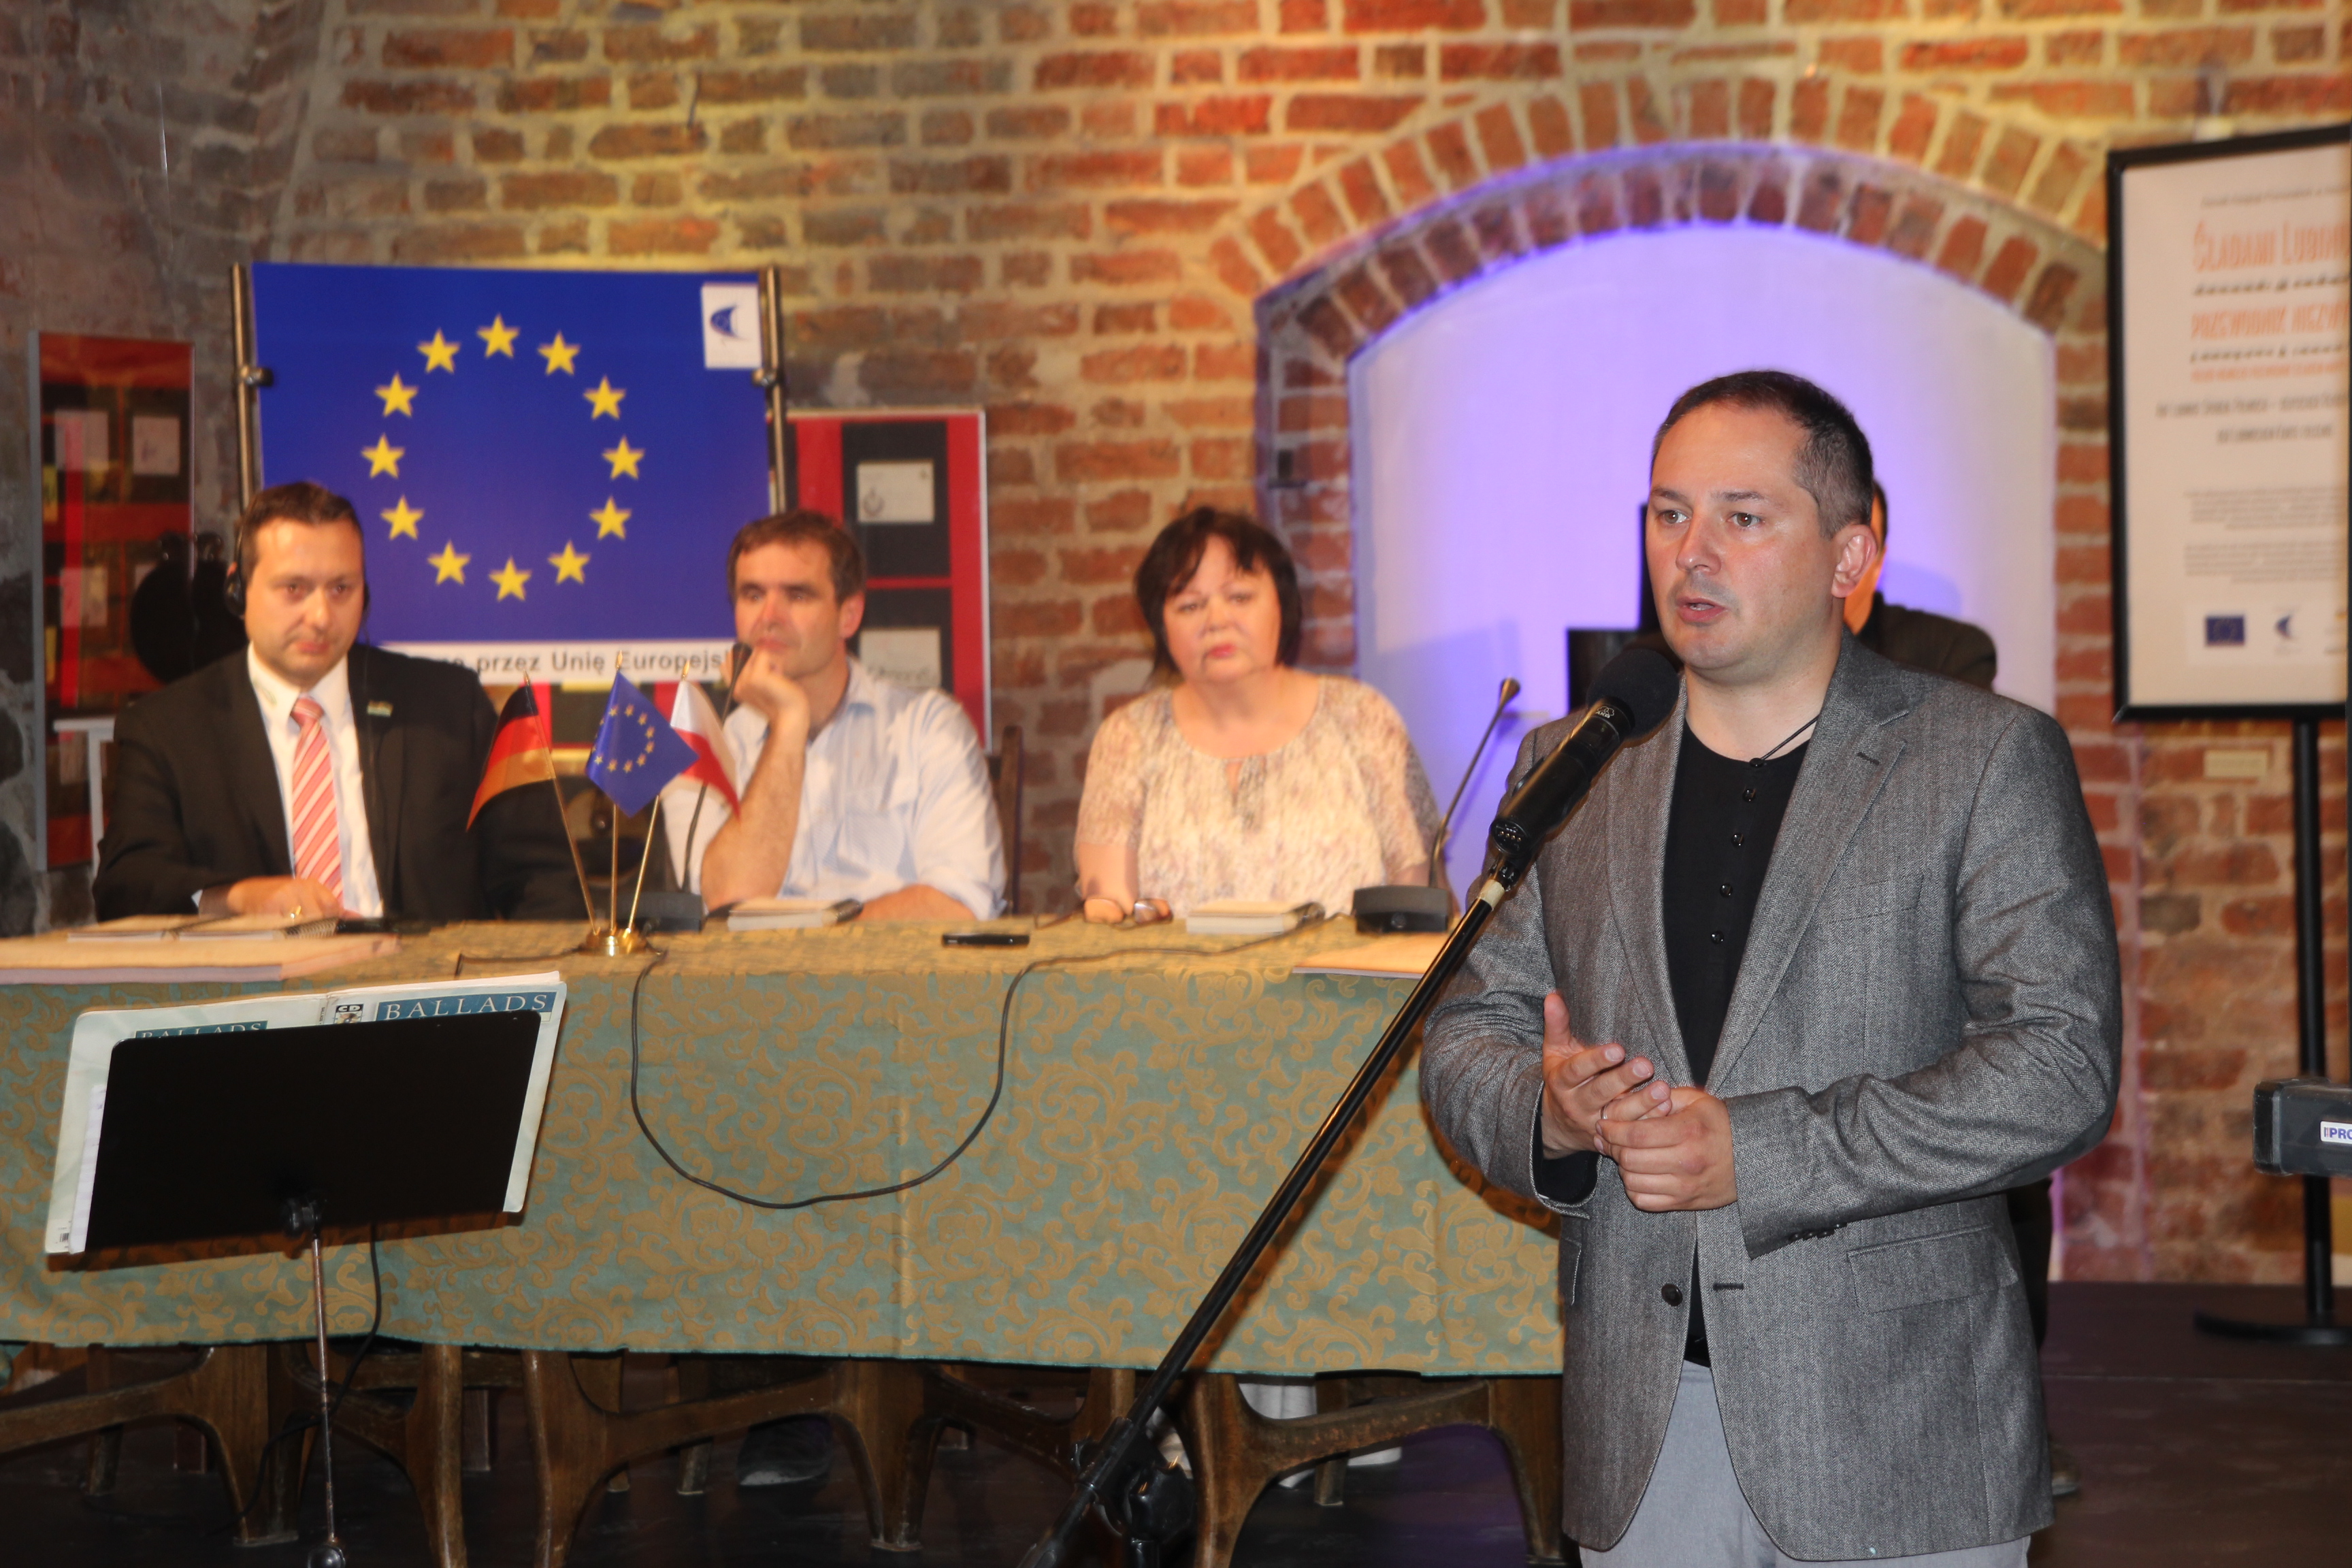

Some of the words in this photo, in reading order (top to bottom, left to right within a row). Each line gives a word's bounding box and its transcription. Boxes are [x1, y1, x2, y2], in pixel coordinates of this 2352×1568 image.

[476, 655, 540, 676] przez
[551, 651, 605, 674] Unię
[616, 649, 729, 675] Europejs
[386, 994, 547, 1020] BALLADS
